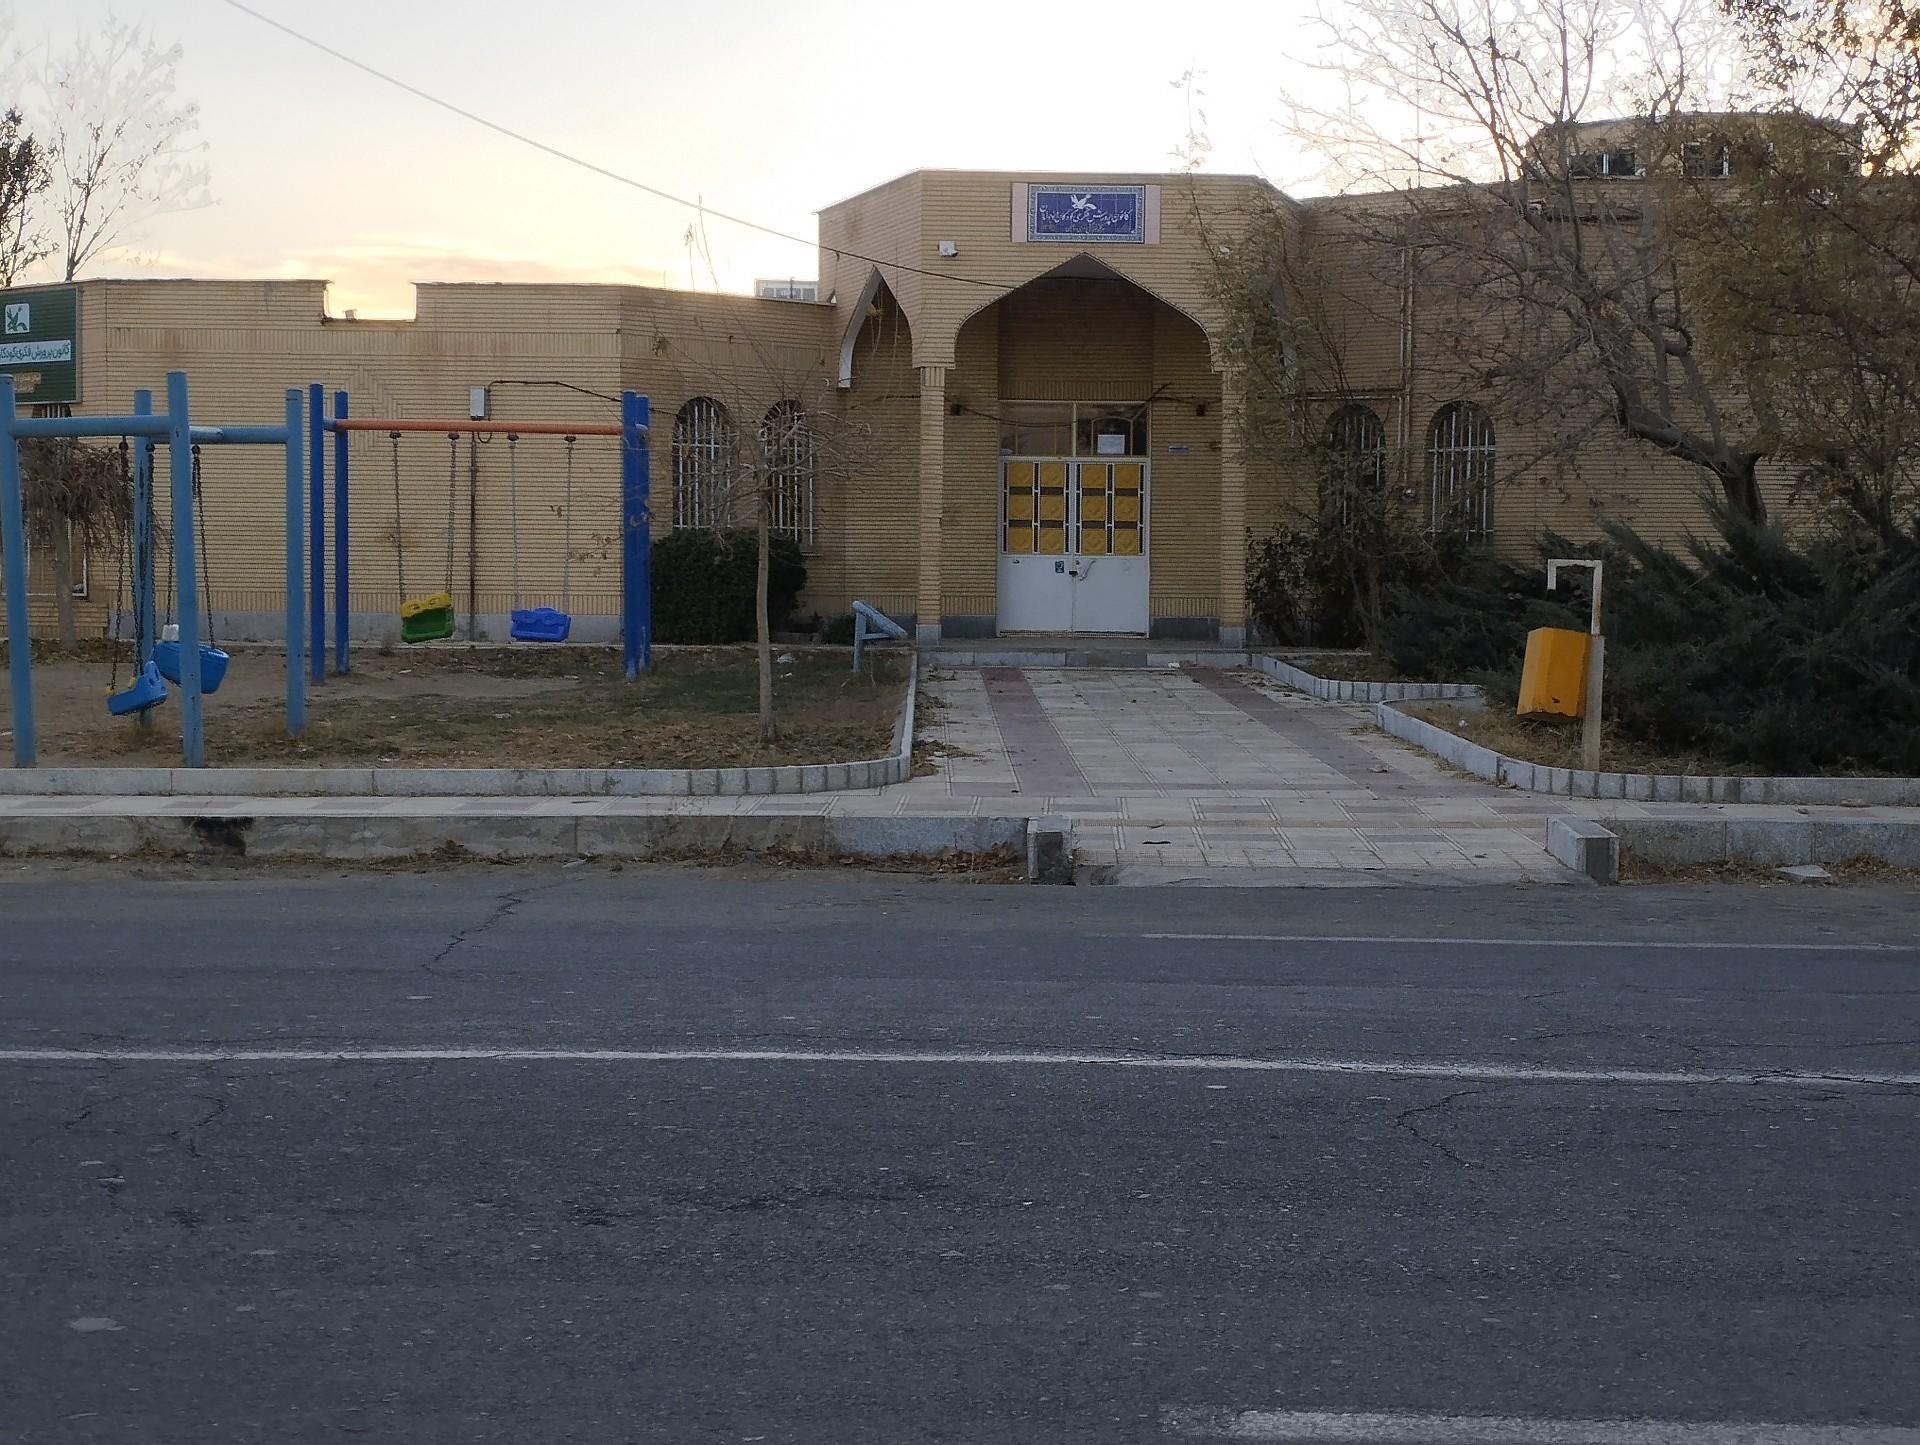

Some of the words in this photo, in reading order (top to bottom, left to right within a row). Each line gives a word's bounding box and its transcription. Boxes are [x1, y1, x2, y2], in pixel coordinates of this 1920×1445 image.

[1087, 208, 1111, 225] پرورش
[1110, 208, 1133, 223] کانون
[16, 345, 31, 361] فکری
[31, 345, 52, 360] پرورش
[52, 342, 70, 359] کانون
